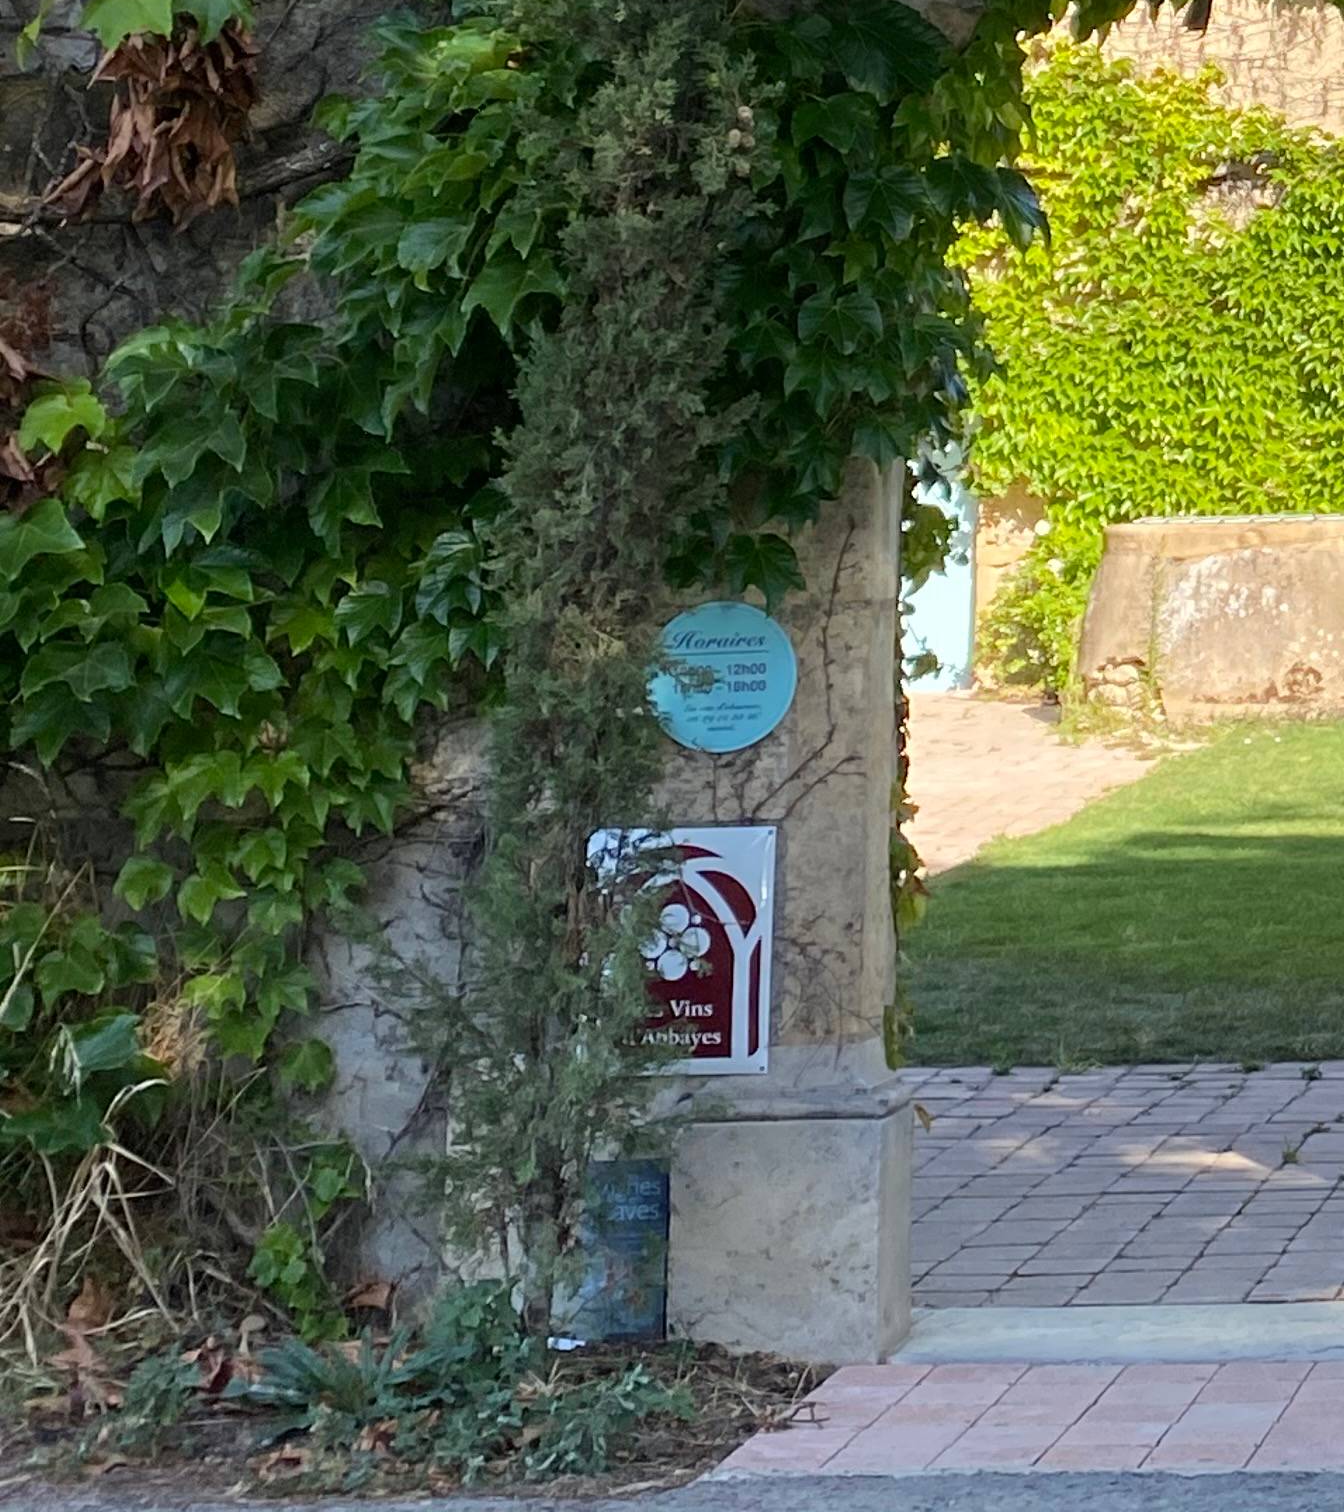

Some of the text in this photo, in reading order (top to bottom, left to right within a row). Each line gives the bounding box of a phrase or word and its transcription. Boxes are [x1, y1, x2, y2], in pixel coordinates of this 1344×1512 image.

[665, 631, 766, 649] Horaires
[727, 663, 767, 676] 12h00
[669, 999, 714, 1017] Vins
